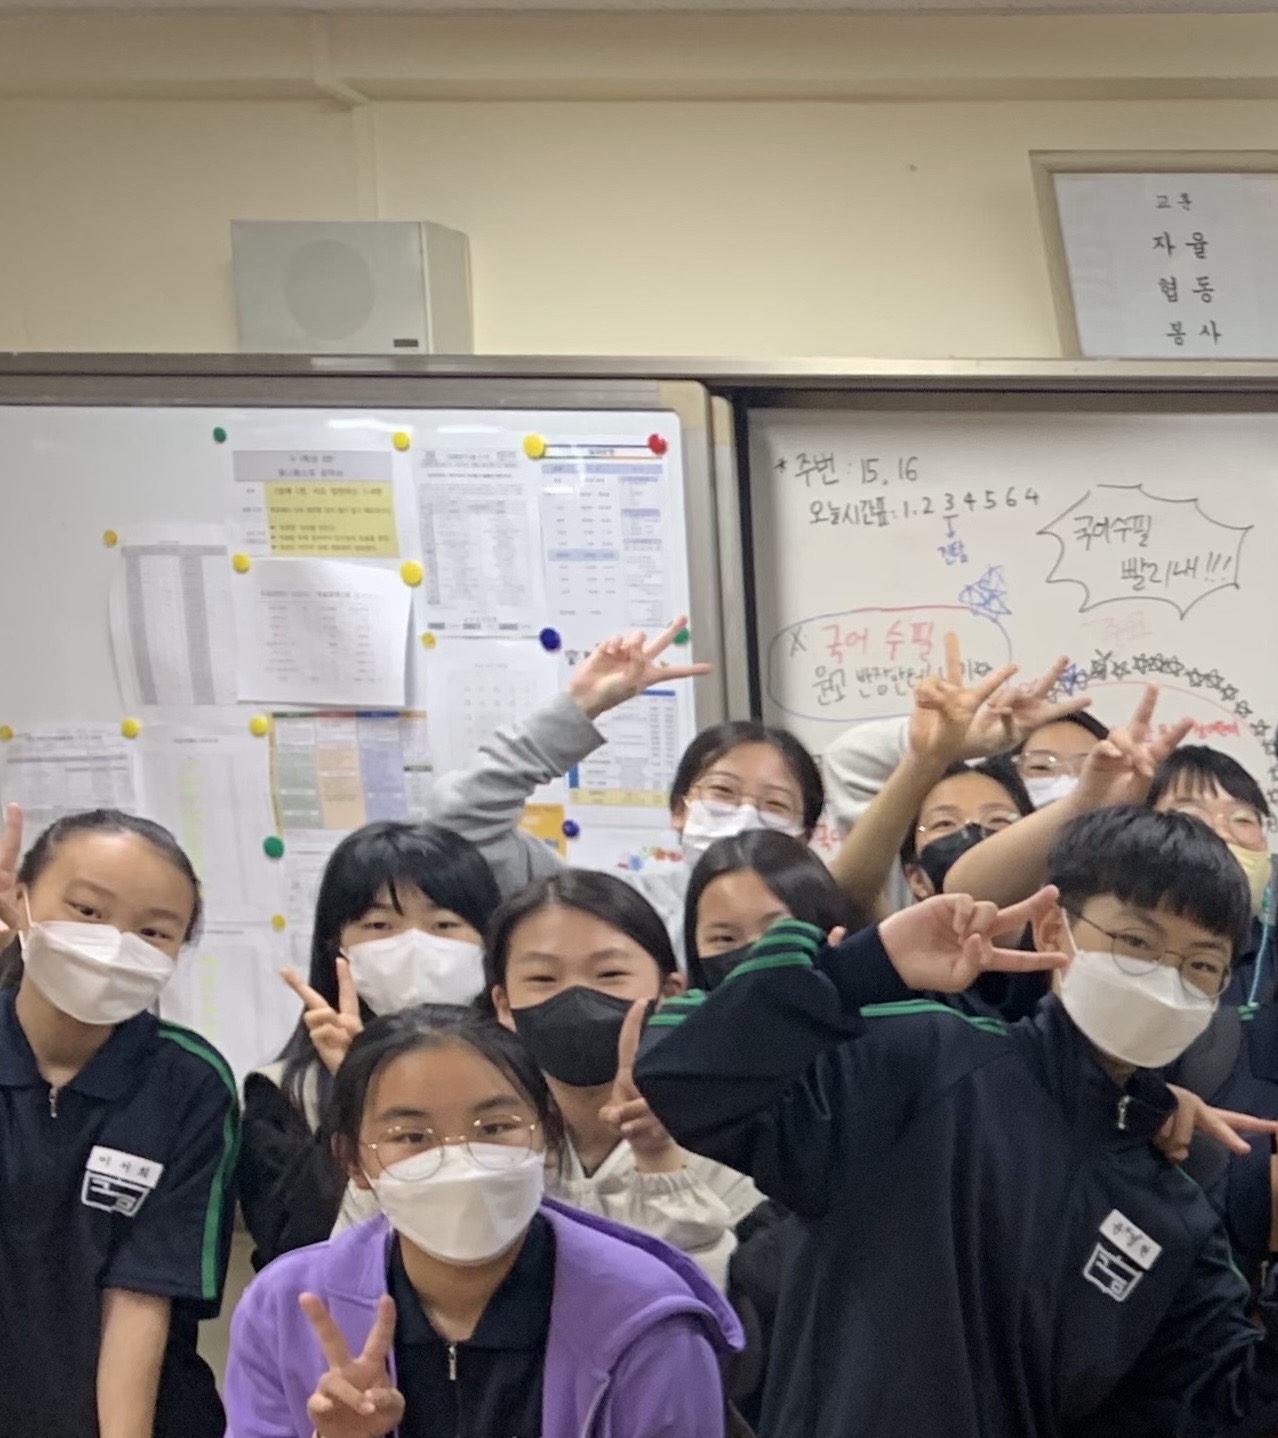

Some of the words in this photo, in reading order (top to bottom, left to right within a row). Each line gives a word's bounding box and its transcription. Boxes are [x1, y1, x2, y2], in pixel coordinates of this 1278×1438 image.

[898, 456, 919, 482] 16
[983, 489, 998, 510] 5
[1005, 486, 1018, 507] 6
[1024, 487, 1040, 505] 4
[822, 623, 869, 665] 국어
